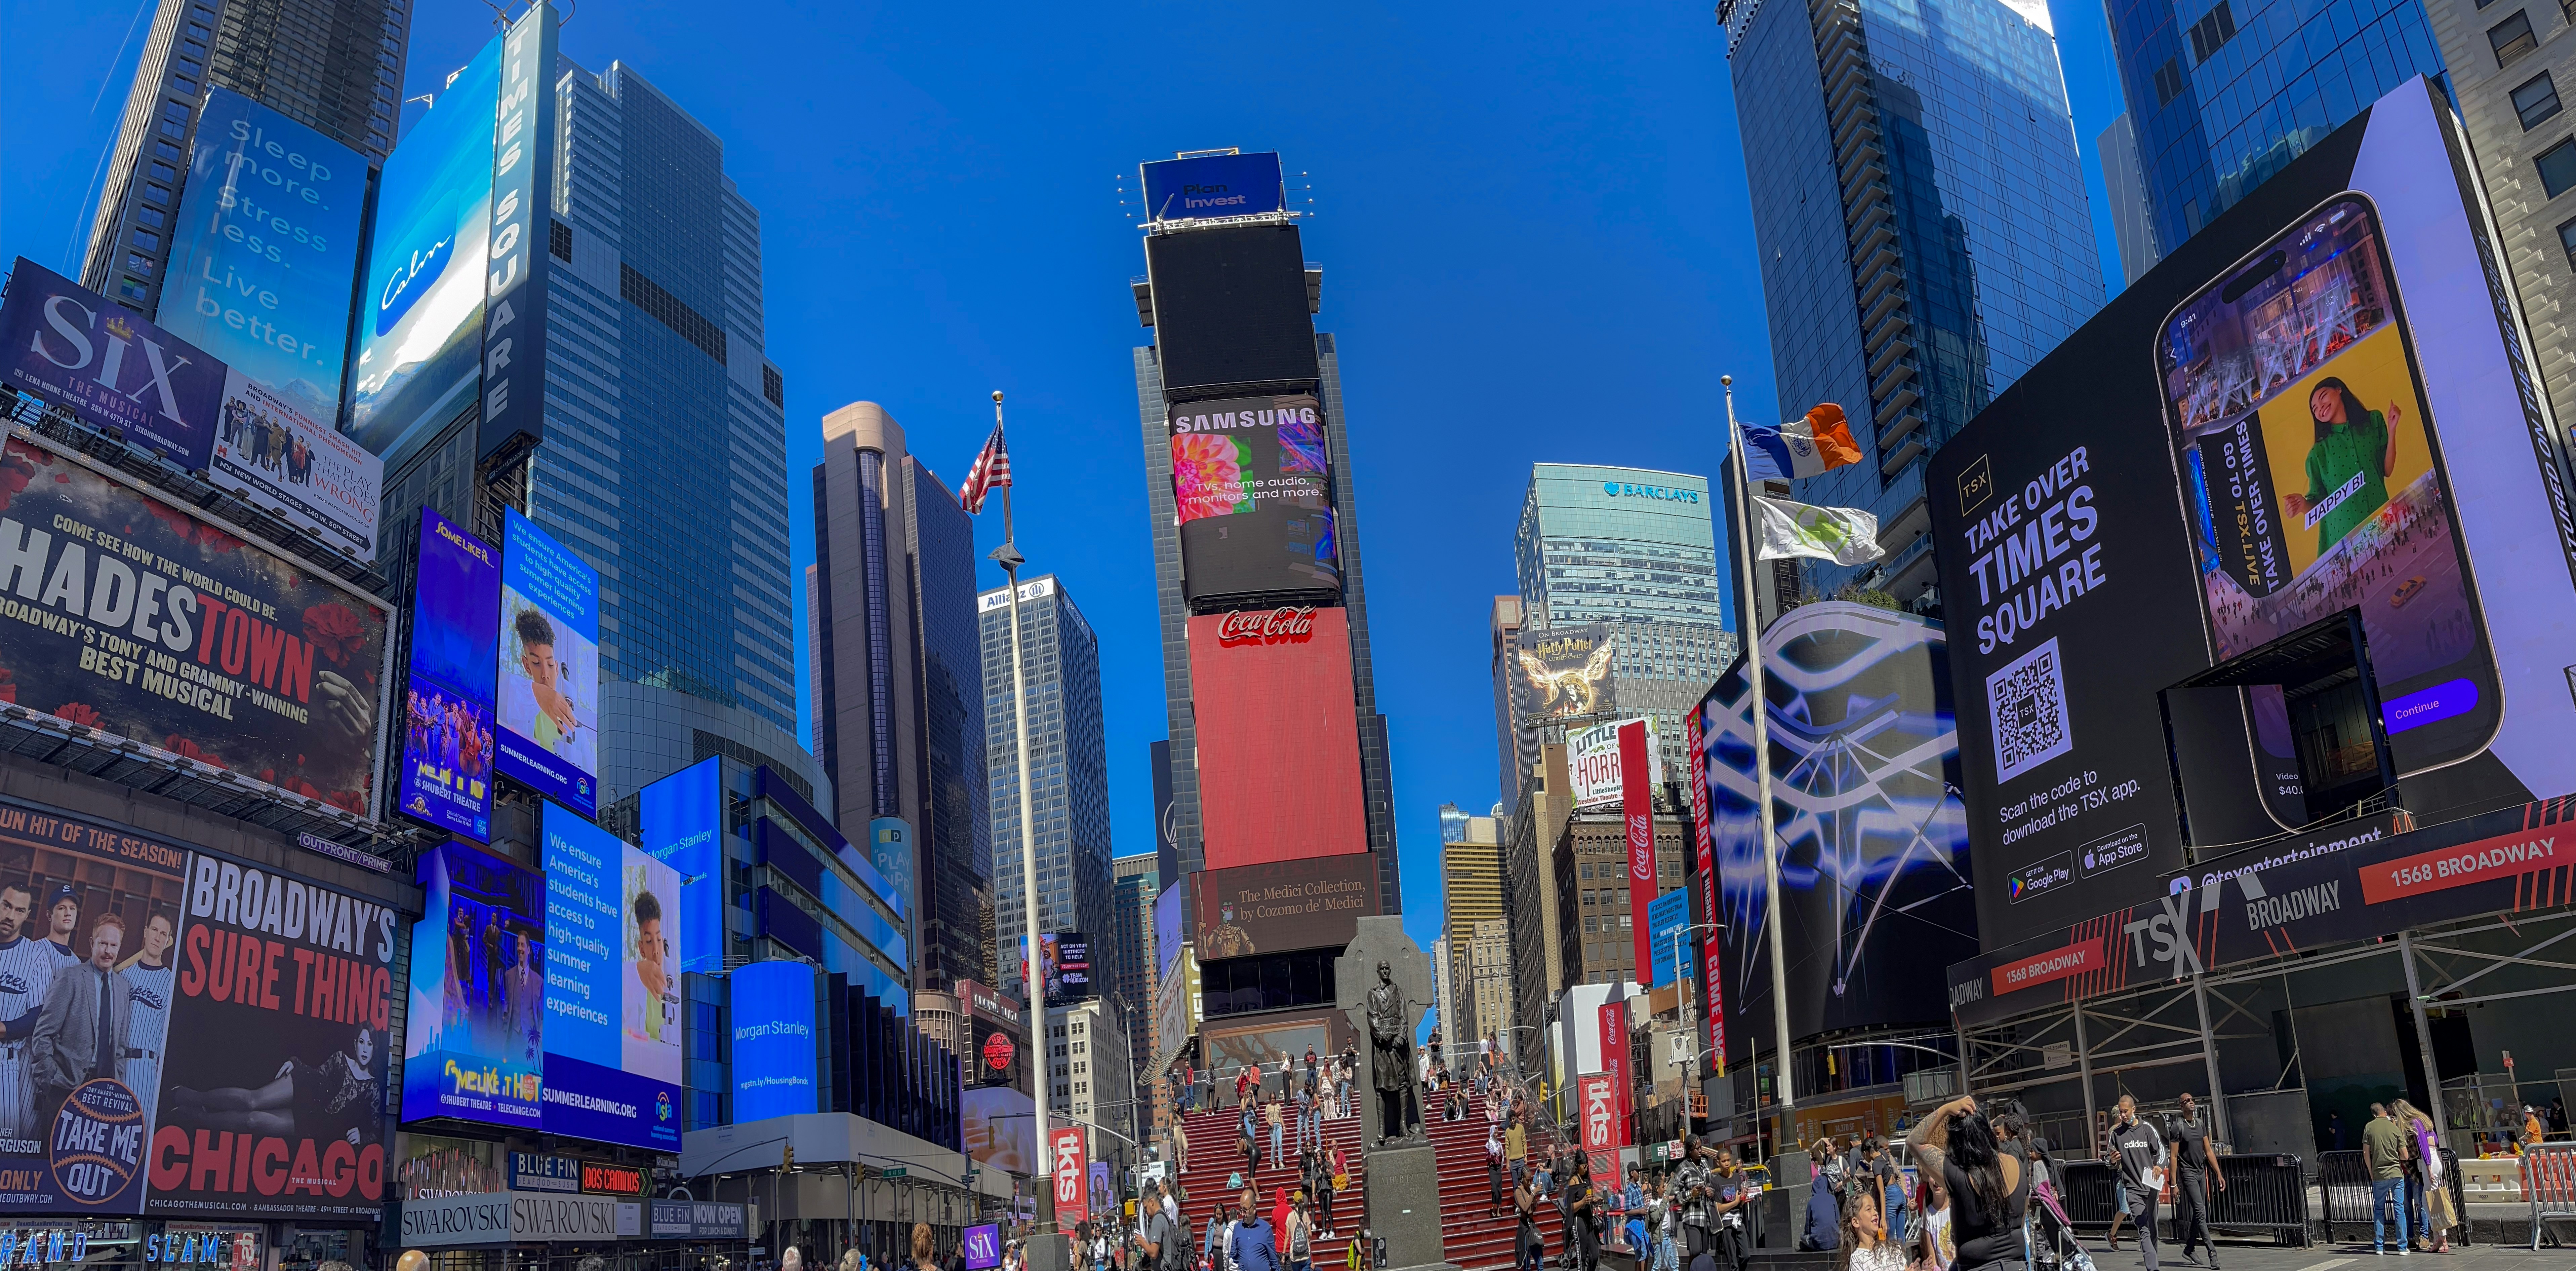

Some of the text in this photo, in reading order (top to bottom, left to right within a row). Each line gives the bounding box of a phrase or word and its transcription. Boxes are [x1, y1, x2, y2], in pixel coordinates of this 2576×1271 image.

[229, 118, 332, 183] Sleep
[224, 150, 330, 210] more.
[1183, 183, 1227, 195] Plan
[215, 185, 328, 253] Stress
[1185, 194, 1246, 208] Invest
[210, 213, 291, 269] less.
[486, 25, 529, 425] TIMES SQUARE
[203, 256, 279, 310] Live
[381, 235, 451, 311] Calm
[196, 287, 324, 366] better.
[2180, 312, 2197, 329] 9:41
[31, 296, 192, 427] SIX
[25, 374, 41, 387] LENA
[41, 381, 62, 396] HORNE
[62, 390, 88, 407] THEATRE
[90, 403, 103, 414] 256
[103, 409, 109, 417] W
[109, 413, 123, 426] 47TH
[134, 425, 190, 457] SIXONBROADWAY.COM
[68, 376, 155, 428] THE MUSICAL
[247, 383, 362, 458] BROADWAY'S FUNNIEST SMASH HIT
[1176, 407, 1315, 433] SAMSUNG
[316, 462, 375, 506] THAT GOES
[322, 455, 372, 491] THE PLAY
[1196, 477, 1310, 492] TVs, home audio,
[1963, 472, 1987, 498] TSX
[314, 473, 374, 523] WRONG
[314, 493, 370, 530] BROADWAYGOESWRONG.COM
[1624, 483, 1698, 504] BARCLAYS
[1965, 446, 2089, 554] TAKE OVER
[2308, 483, 2349, 526] HAPPY
[2223, 442, 2261, 586] GO TO TSX.LIVE
[1969, 485, 2097, 606] TIMES
[53, 513, 279, 622] COME SEE HOW THE WORLD COULD BE.
[0, 516, 315, 706] HADESTOWN
[1977, 542, 2106, 655] SQUARE
[1536, 638, 1593, 659] Harry Potter
[79, 645, 234, 721] BEST MUSICAL
[2395, 699, 2440, 720] Continue
[1576, 725, 1616, 756] LITTLE
[1577, 797, 1599, 805] Westside
[1689, 712, 1709, 860] FREE CHOCOLATE
[2000, 770, 2097, 823] Scan the code to
[2003, 779, 2140, 845] download the TSX app.
[303, 836, 388, 871] OUTFRONT PRIME
[1633, 813, 1650, 880] Coca-Cola
[2097, 838, 2121, 852] Download
[2099, 842, 2142, 865] App Store
[2391, 837, 2555, 888] 1568 BROADWAY
[1238, 879, 1366, 903] The Medici Collection,
[2027, 869, 2068, 890] Google Play
[191, 855, 396, 964] BROADWAY'S
[1651, 894, 1682, 912] ATTACKS ORTHODOX
[2247, 881, 2341, 931] BROADWAY
[2124, 892, 2204, 979] TSX
[181, 924, 391, 1031] SURE THING
[735, 1020, 809, 1041] Morgan Stanley
[1607, 1007, 1616, 1045] Coca-Cola
[992, 1058, 1006, 1066] NOW
[740, 1075, 808, 1090] mgstn.ly/HousingBonds
[82, 1093, 132, 1112] BEST REVIVAL
[542, 1087, 636, 1118] SUMMERLEARNING.ORG
[1588, 1079, 1610, 1145] tkts
[57, 1110, 142, 1165] TAKE ME
[1835, 1123, 1849, 1133] 14,370
[2123, 1140, 2147, 1149] adidas
[67, 1163, 113, 1196] OUT
[148, 1125, 384, 1200] CHICAGO
[518, 1153, 577, 1178] BLUE FIN
[585, 1167, 639, 1192] DOS CAMINOS
[1058, 1133, 1079, 1202] tkts
[150, 1199, 246, 1210] CHICAGOTHEMUSICAL.COM
[403, 1203, 509, 1236] SWAROVSKI
[514, 1198, 615, 1234] SWAROVSKI
[694, 1204, 741, 1224] NOW OPEN
[148, 1234, 219, 1262] SLAM
[969, 1235, 995, 1261] SIX
